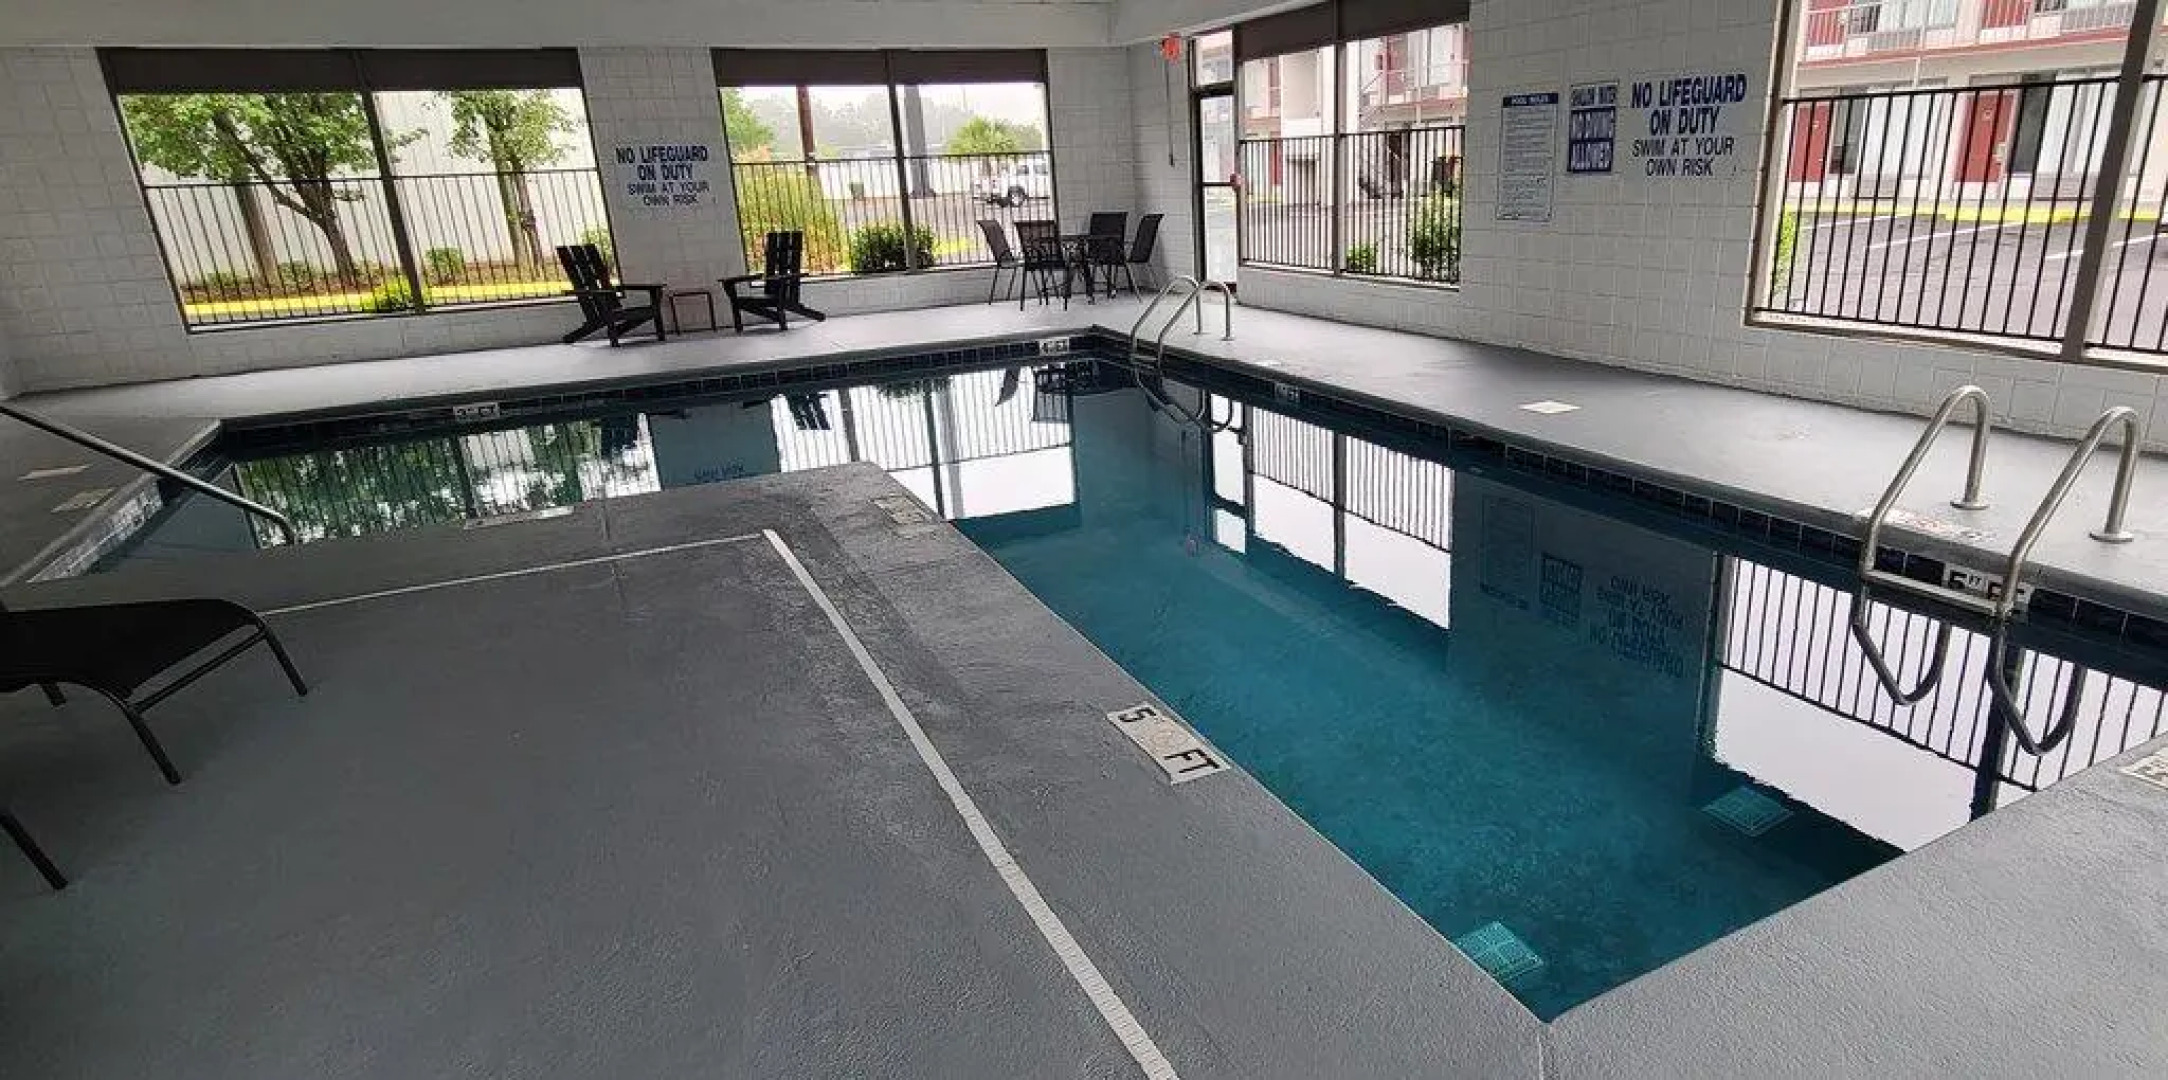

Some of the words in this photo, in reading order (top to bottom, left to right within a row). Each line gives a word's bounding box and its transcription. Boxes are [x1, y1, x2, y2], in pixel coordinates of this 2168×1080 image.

[1631, 82, 1652, 108] NO
[1660, 74, 1747, 106] LIFEGUARD
[1651, 109, 1669, 135] ON
[1679, 107, 1720, 134] DUTY
[616, 147, 636, 164] NO
[640, 146, 708, 163] LIFEGUARD
[1632, 138, 1664, 157] SWIM
[1671, 138, 1691, 155] AT
[1695, 137, 1735, 155] YOUR
[637, 164, 656, 181] ON
[660, 163, 693, 180] DUTY
[1646, 158, 1677, 176] OWN
[1681, 158, 1713, 176] RISK
[628, 182, 656, 195] SWIM
[661, 182, 674, 195] AT
[679, 181, 710, 193] YOUR
[643, 195, 669, 206] OWN
[673, 194, 699, 205] RISK
[1117, 707, 1157, 723] 5
[1163, 748, 1220, 774] FT
